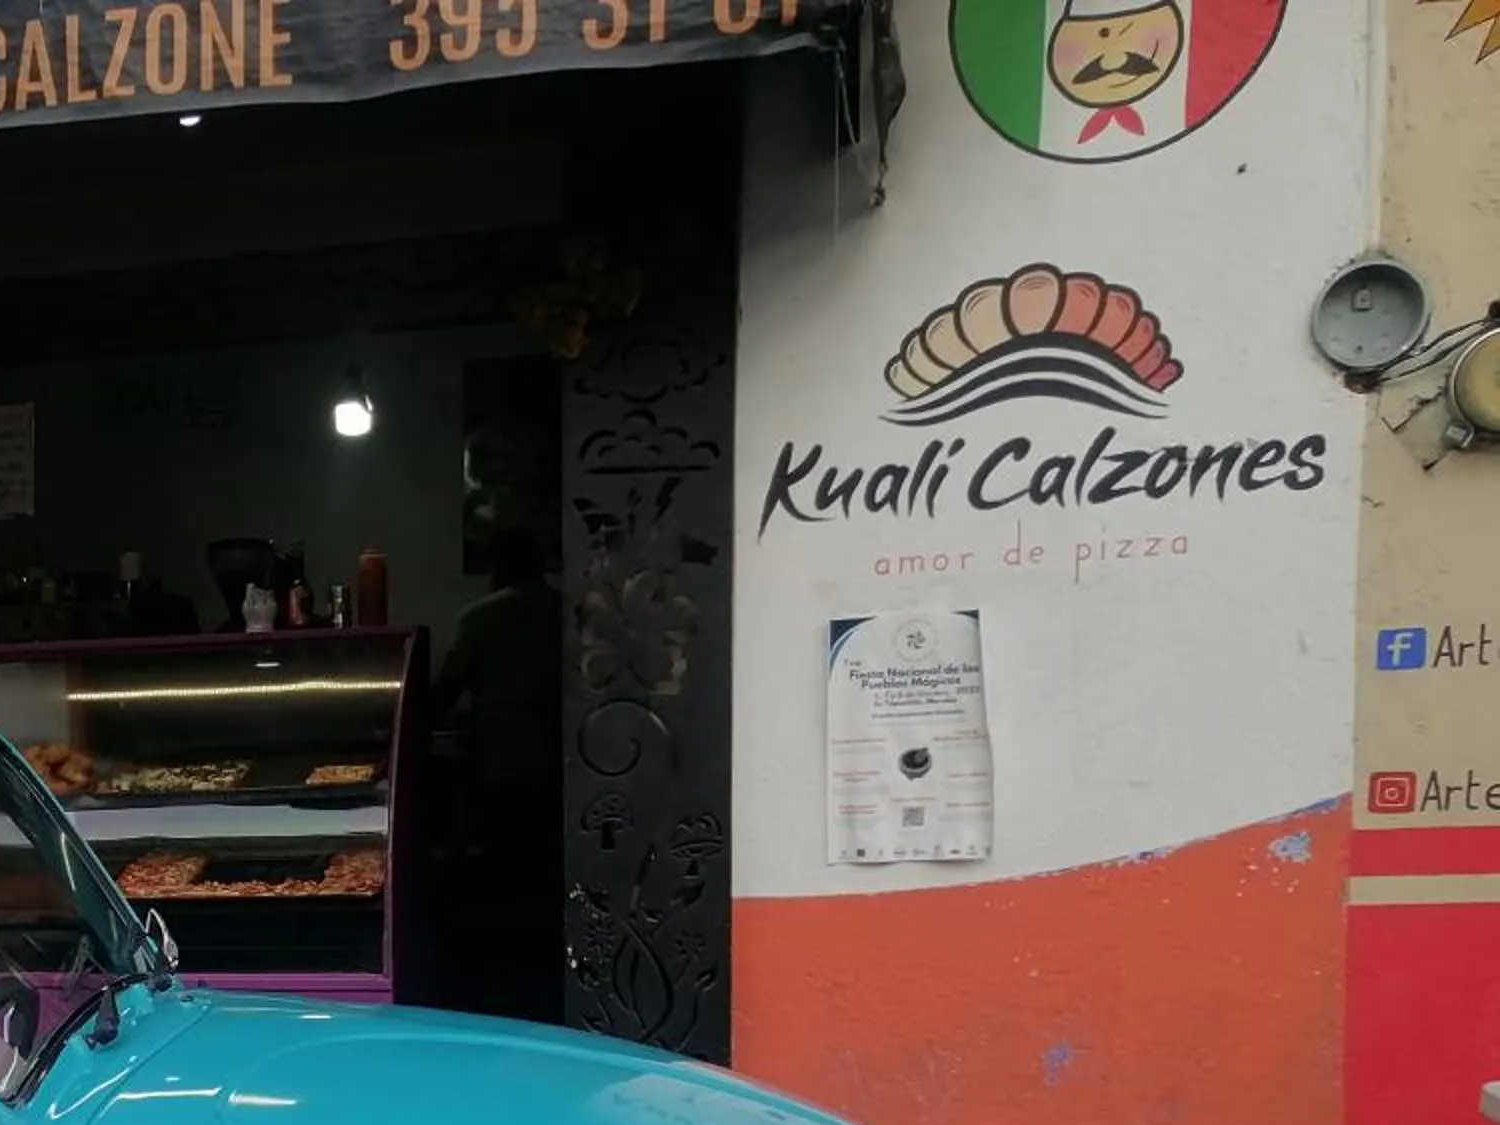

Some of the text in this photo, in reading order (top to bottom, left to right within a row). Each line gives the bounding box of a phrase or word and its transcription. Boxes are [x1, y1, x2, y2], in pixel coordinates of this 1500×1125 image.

[967, 426, 1327, 512] Calzones
[874, 519, 1189, 584] amor de pizza
[1432, 623, 1500, 668] Art
